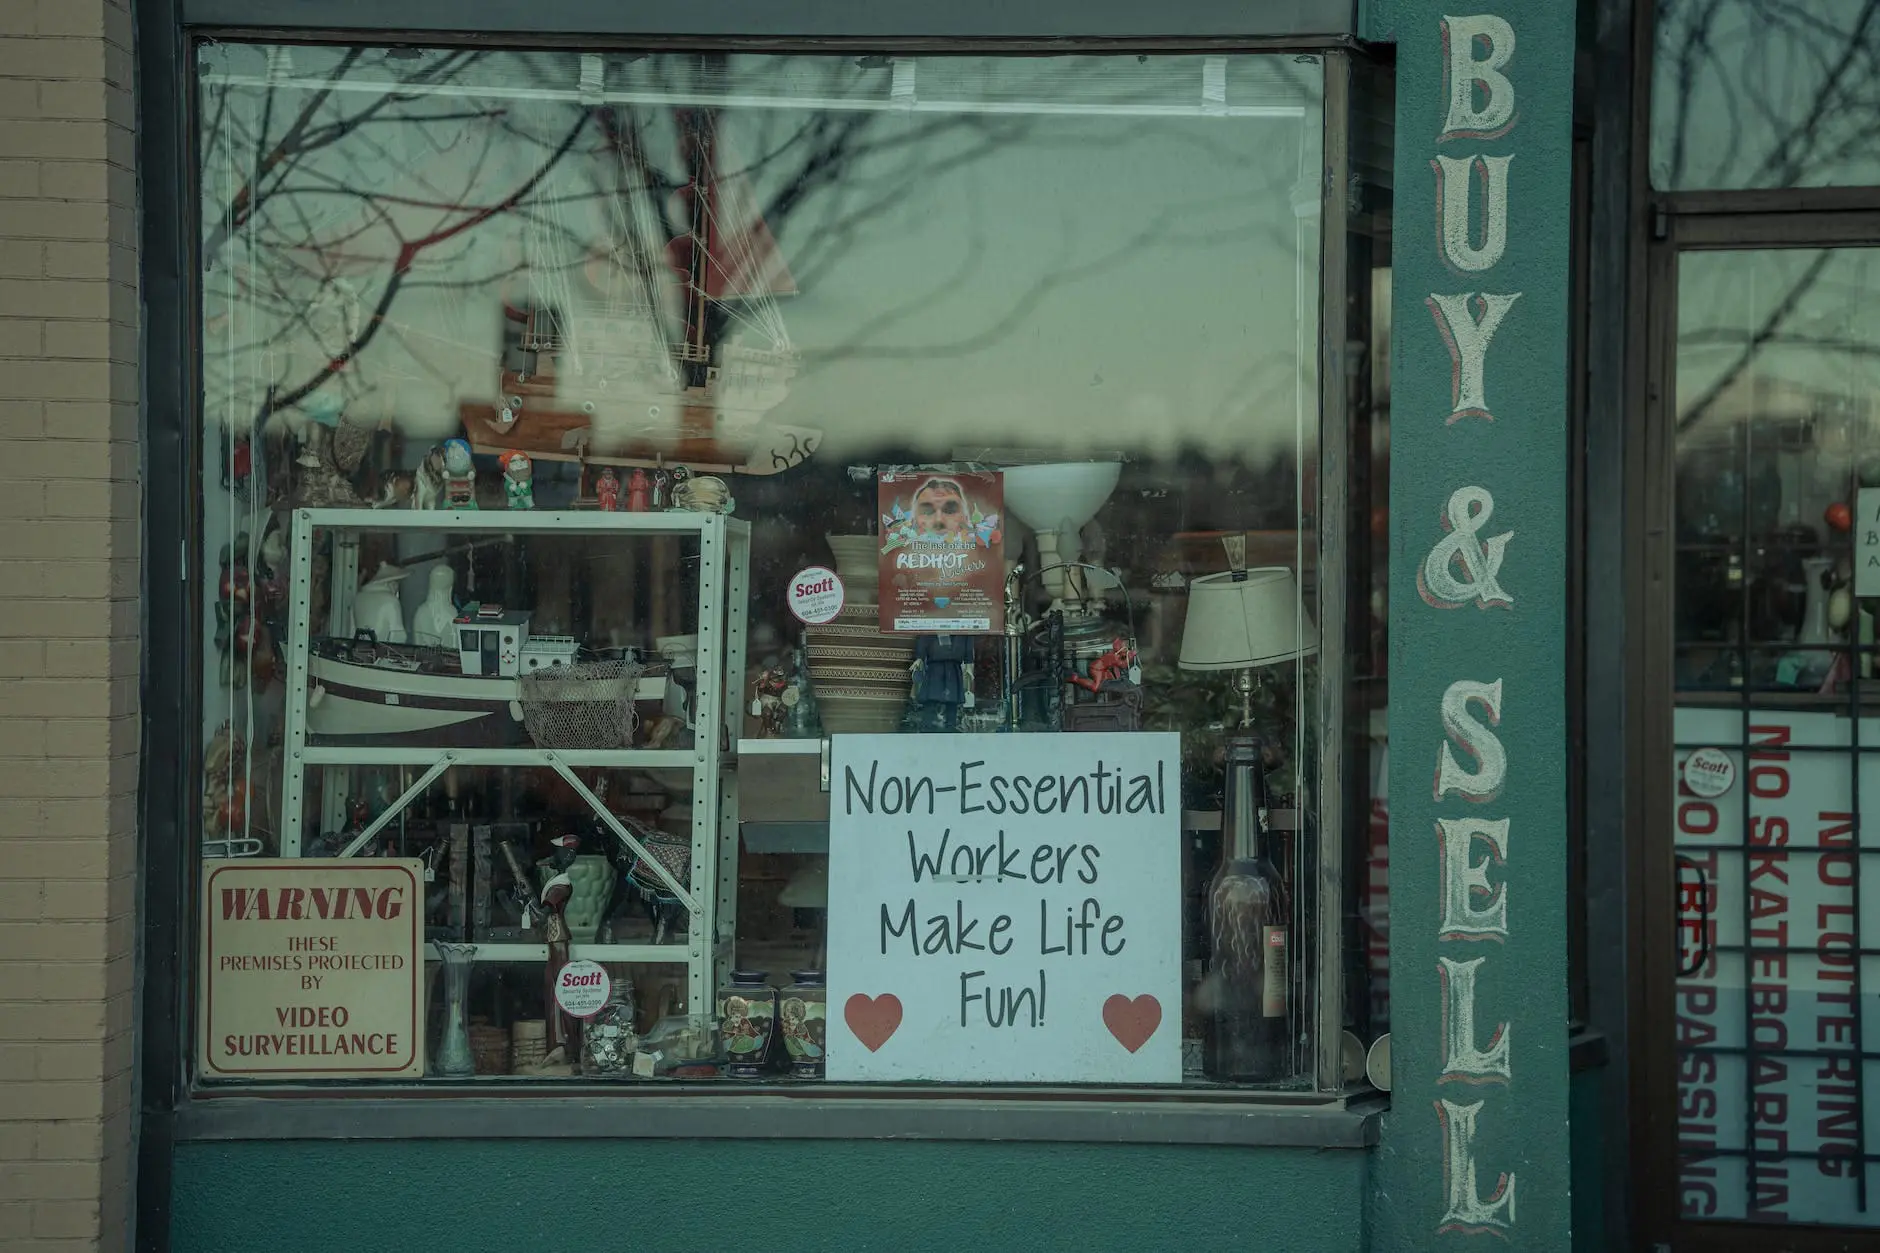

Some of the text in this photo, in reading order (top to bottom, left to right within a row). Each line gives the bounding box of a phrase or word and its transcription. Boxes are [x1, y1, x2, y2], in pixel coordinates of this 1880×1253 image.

[960, 540, 976, 550] the
[896, 552, 969, 569] REDHOT
[795, 577, 834, 598] Scott
[1417, 14, 1523, 1238] BUY & SELL
[1691, 756, 1729, 775] Scott
[1748, 724, 1791, 799] NO
[845, 760, 1165, 815] Non-Essential
[1677, 760, 1719, 835] O
[907, 828, 1101, 884] Workers
[221, 887, 404, 921] WARNING
[880, 898, 1126, 956] Make Life
[287, 936, 339, 952] THESE
[220, 954, 404, 971] PREMISES PROTECTED
[301, 975, 324, 990] BY
[562, 971, 602, 987] Scott
[960, 969, 1047, 1028] Fun!
[1816, 810, 1861, 1179] NO LOITERING
[276, 1006, 349, 1028] VIDEO
[224, 1033, 398, 1056] SURVEILLANCE
